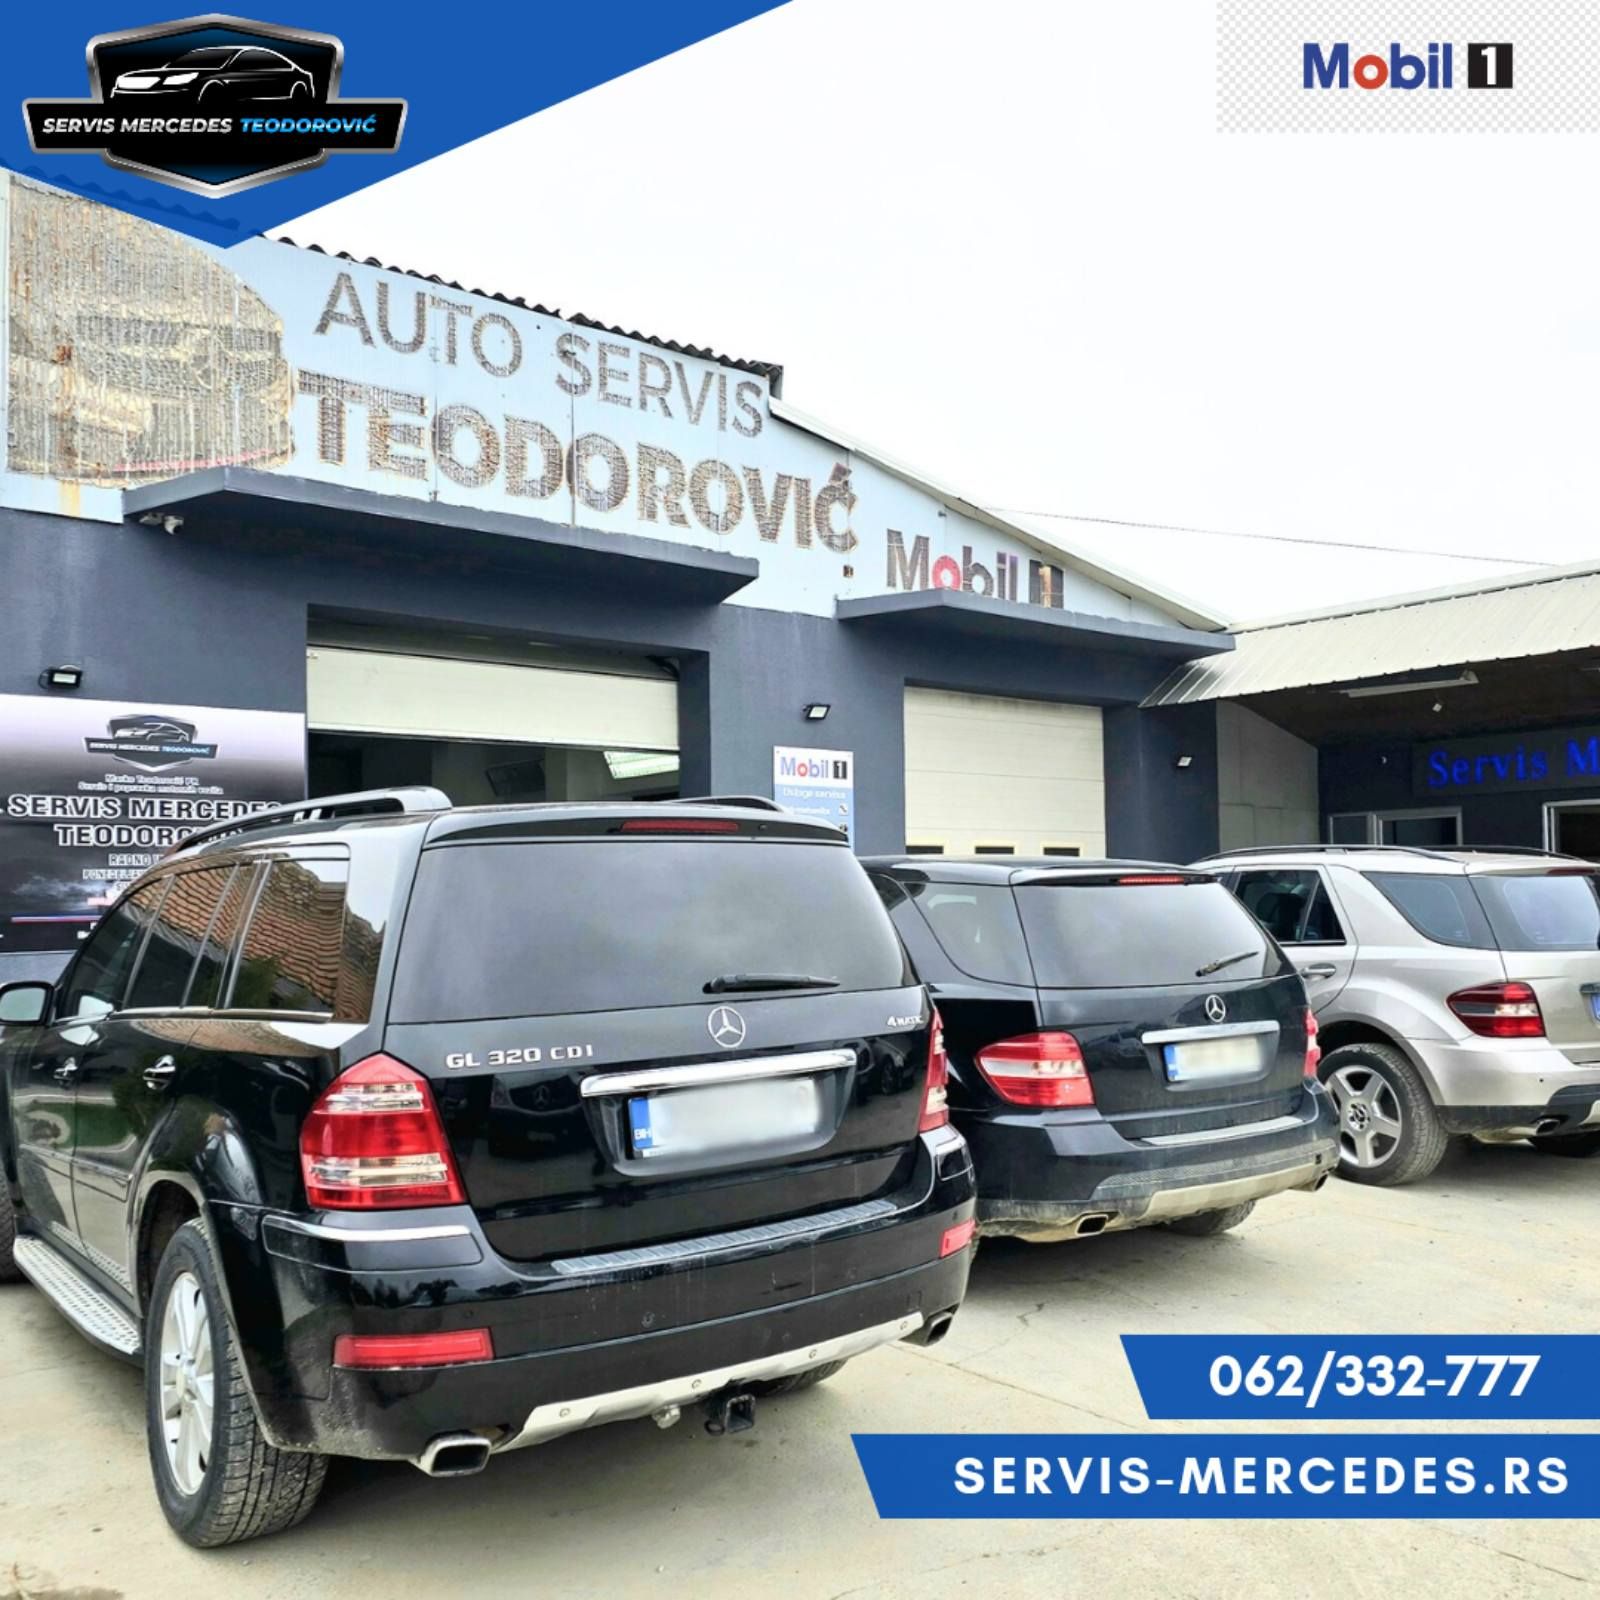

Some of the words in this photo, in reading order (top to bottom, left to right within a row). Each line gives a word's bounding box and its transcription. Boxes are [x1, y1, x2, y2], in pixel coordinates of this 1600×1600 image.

[313, 271, 523, 379] AUTO
[554, 331, 764, 439] SERVIS
[297, 368, 860, 554] TEODOROVIĆ
[887, 528, 1018, 601] Mobil
[781, 756, 829, 778] Mobil
[1427, 745, 1548, 789] Servis
[8, 794, 121, 818] SERVIS
[446, 1052, 481, 1069] GL
[488, 1047, 541, 1066] 320
[550, 1044, 594, 1060] CDI
